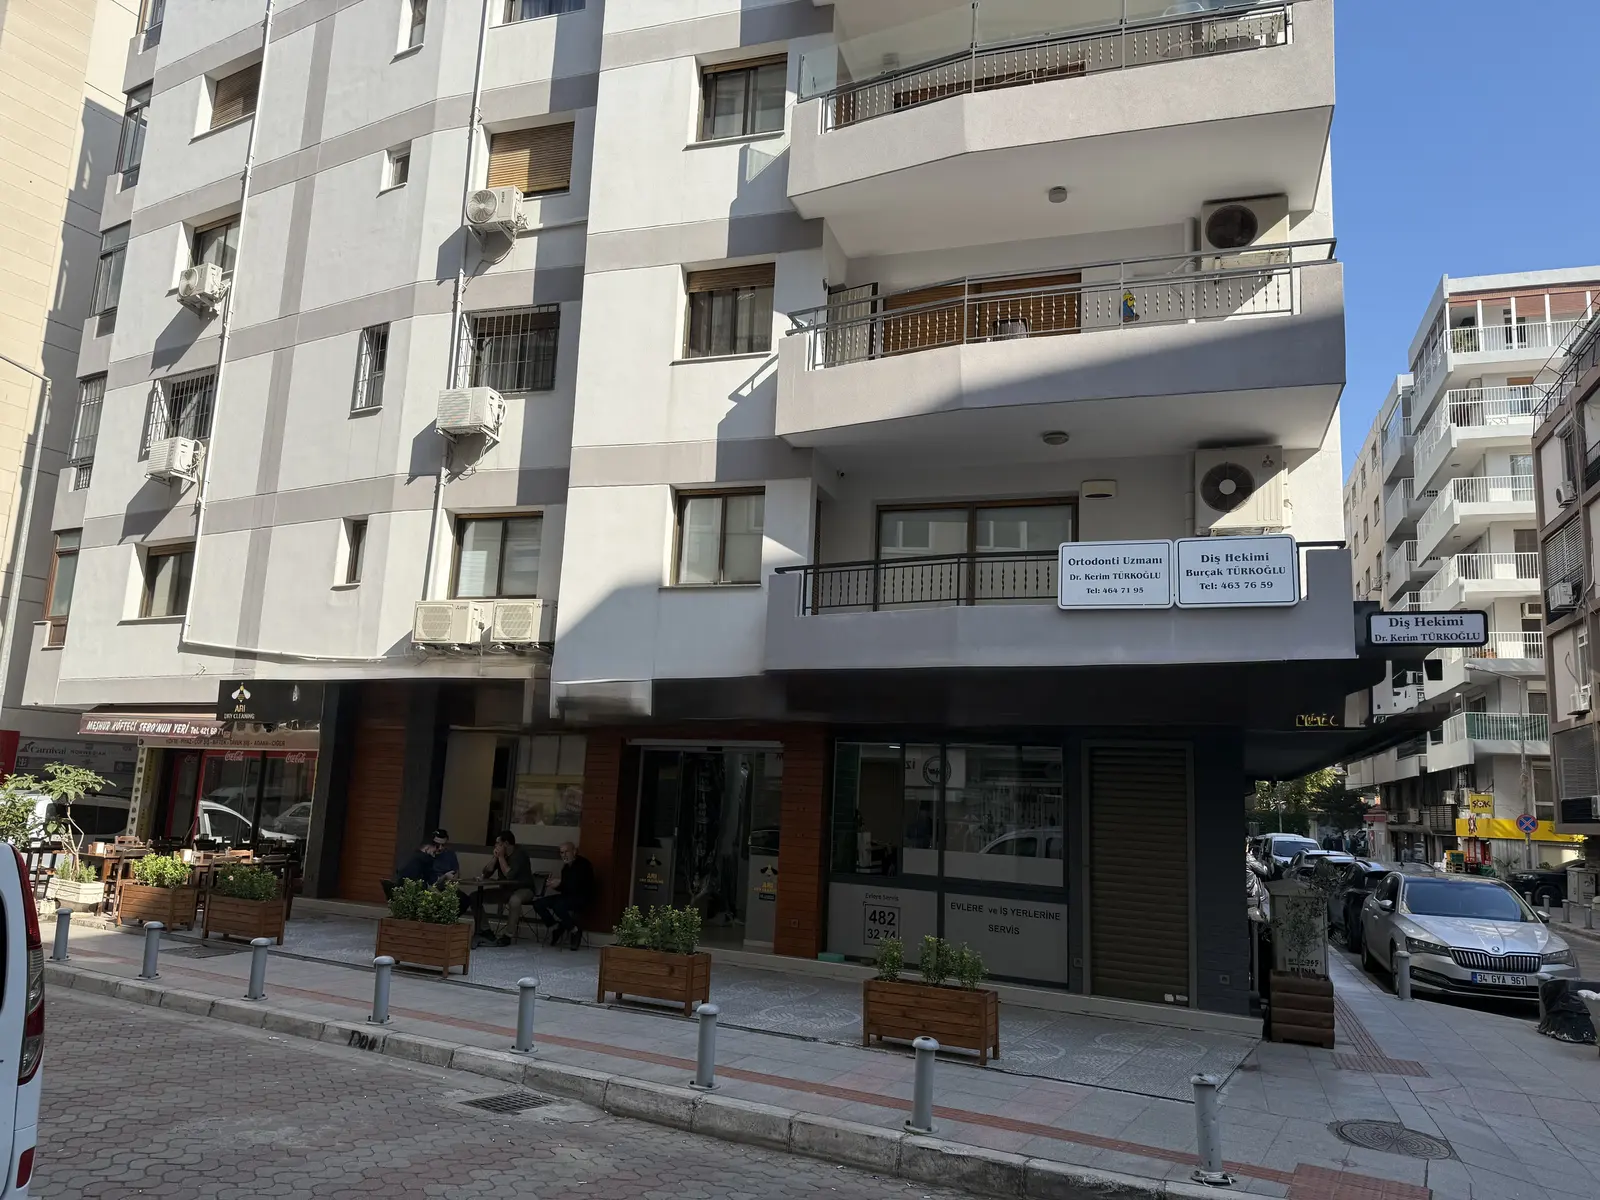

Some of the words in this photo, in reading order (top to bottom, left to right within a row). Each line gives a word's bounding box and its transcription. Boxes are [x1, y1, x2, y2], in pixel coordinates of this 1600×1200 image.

[1068, 556, 1120, 566] Ortodonti
[1123, 556, 1163, 565] Uzmanı
[1201, 553, 1221, 565] Diş
[1225, 552, 1270, 562] Hekimi
[1084, 573, 1110, 581] Kerim
[1113, 570, 1161, 580] TÜRKOĞLU
[1186, 568, 1223, 578] Burçak
[1226, 565, 1286, 576] TÜRKOĞLU
[1199, 582, 1218, 590] Tel:
[1244, 581, 1257, 589] 76
[1260, 581, 1273, 589] 59
[1389, 617, 1410, 629] Diş
[1414, 616, 1464, 627] Hekimi
[1374, 634, 1388, 642] Dr.
[1390, 633, 1418, 642] Kerim
[1420, 631, 1480, 641] TÜRKOĞLU
[234, 704, 246, 713] ARI
[112, 719, 139, 731] KÖFTECİ
[173, 721, 191, 734] YERİ
[869, 909, 896, 926] 482
[950, 902, 984, 914] EVLERE
[988, 907, 998, 915] ve
[999, 906, 1009, 918] İŞ
[1010, 907, 1061, 921] YERLERİNE
[867, 928, 880, 940] 32
[988, 922, 1020, 936] SERVİS
[1477, 973, 1488, 983] 34
[1491, 975, 1506, 984] GYA
[1510, 976, 1525, 985] 961
